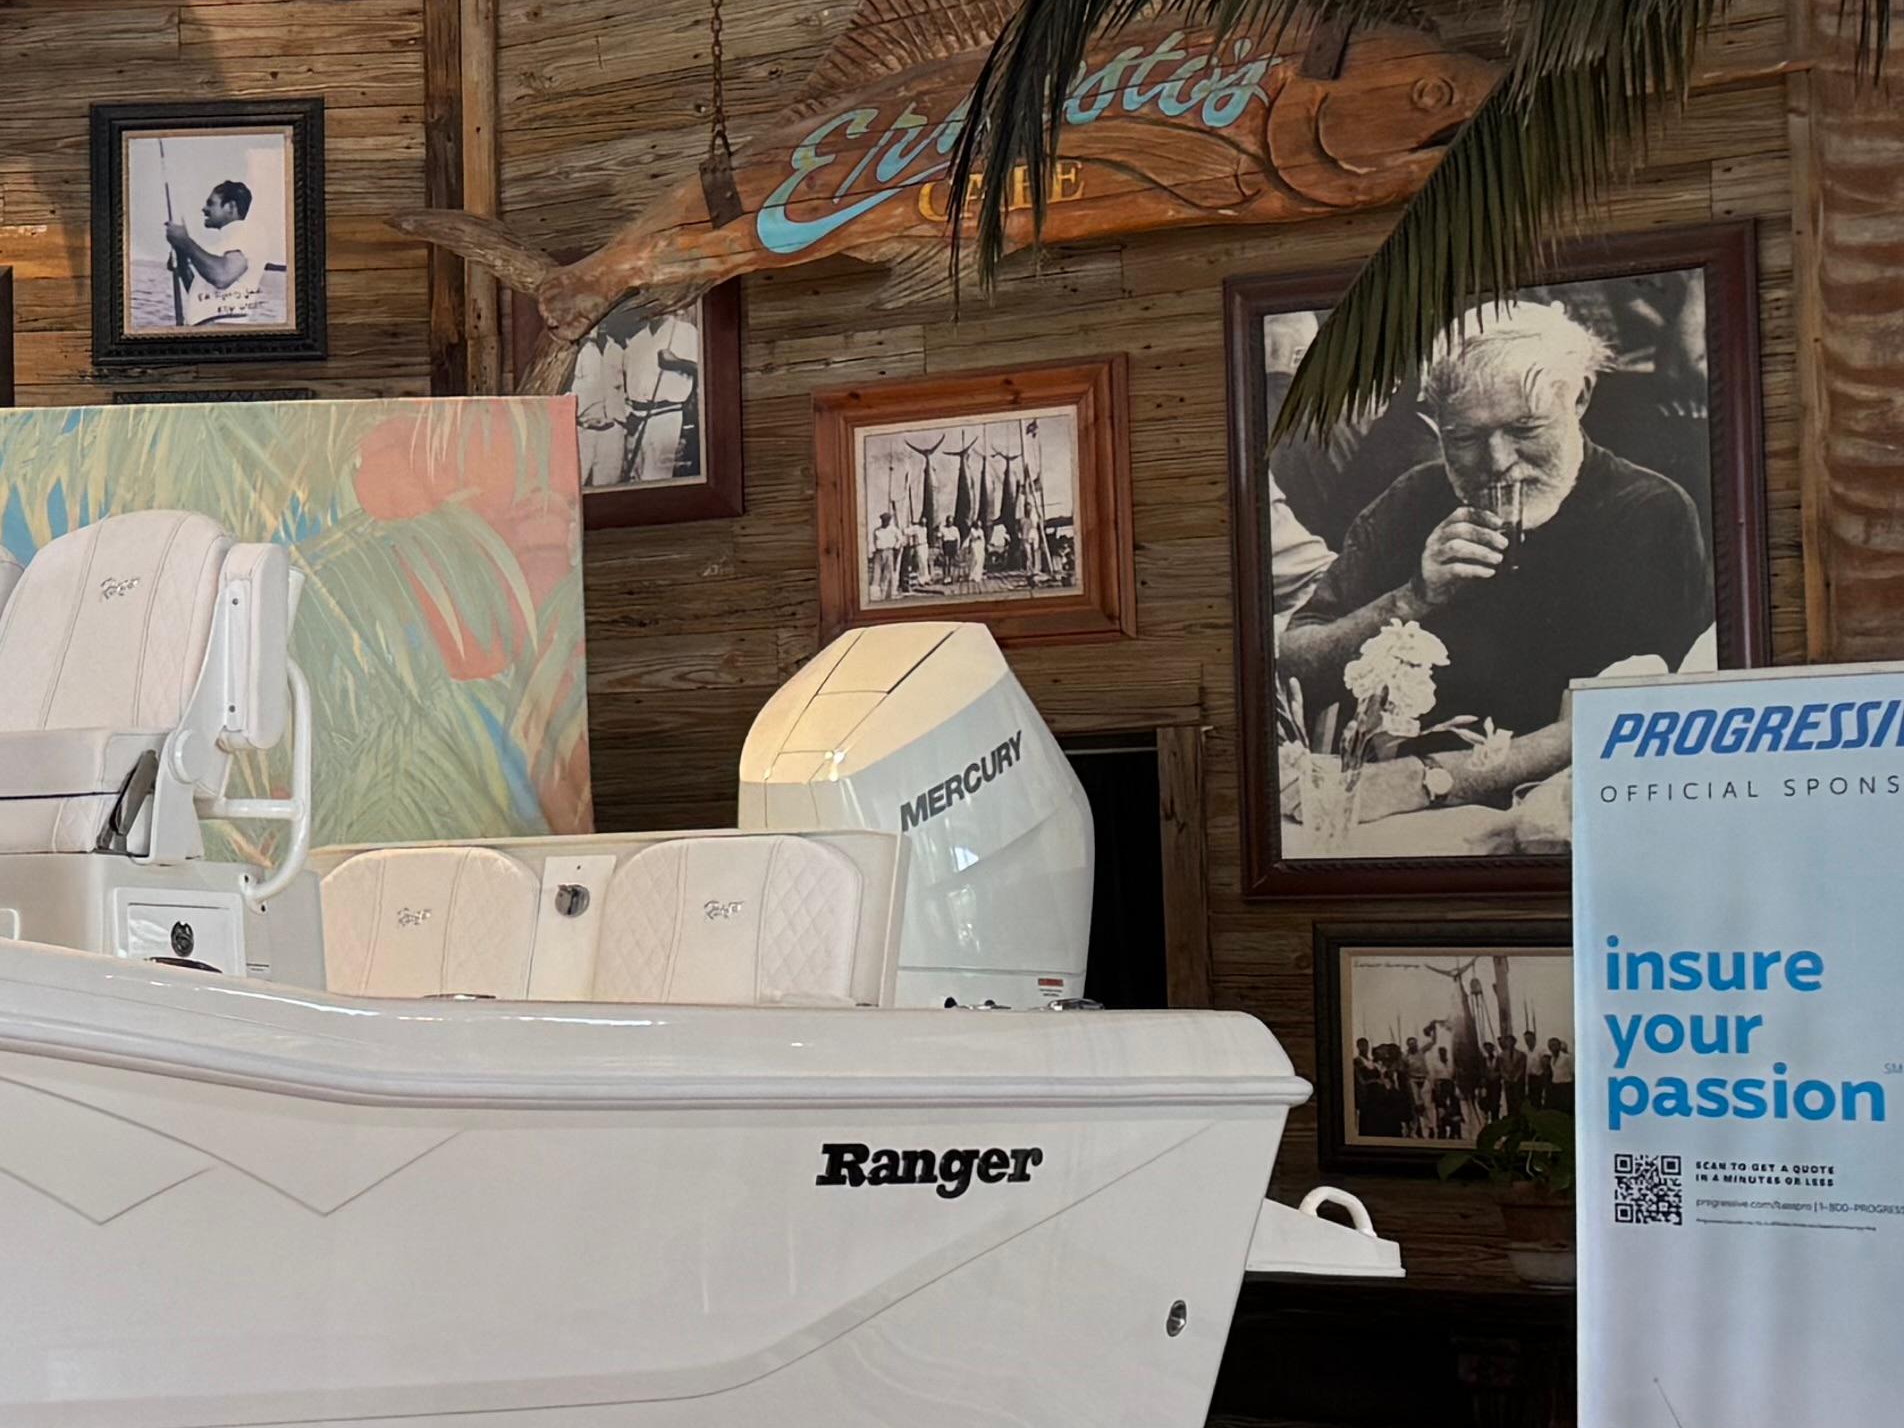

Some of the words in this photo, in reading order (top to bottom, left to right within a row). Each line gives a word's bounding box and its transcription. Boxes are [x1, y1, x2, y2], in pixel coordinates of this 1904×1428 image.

[900, 730, 1022, 832] MERCURY
[1600, 780, 1759, 803] OFFICIAL
[1606, 935, 1824, 992] insure
[1604, 1012, 1763, 1068] your
[1607, 1062, 1886, 1130] passion
[816, 1143, 1043, 1199] Ranger
[1696, 1161, 1726, 1171] SCAN
[1730, 1162, 1747, 1172] TO
[1751, 1163, 1776, 1173] GET
[1780, 1164, 1789, 1173] A
[1792, 1165, 1835, 1175] QUOTE
[1723, 1175, 1781, 1185] MINUTES
